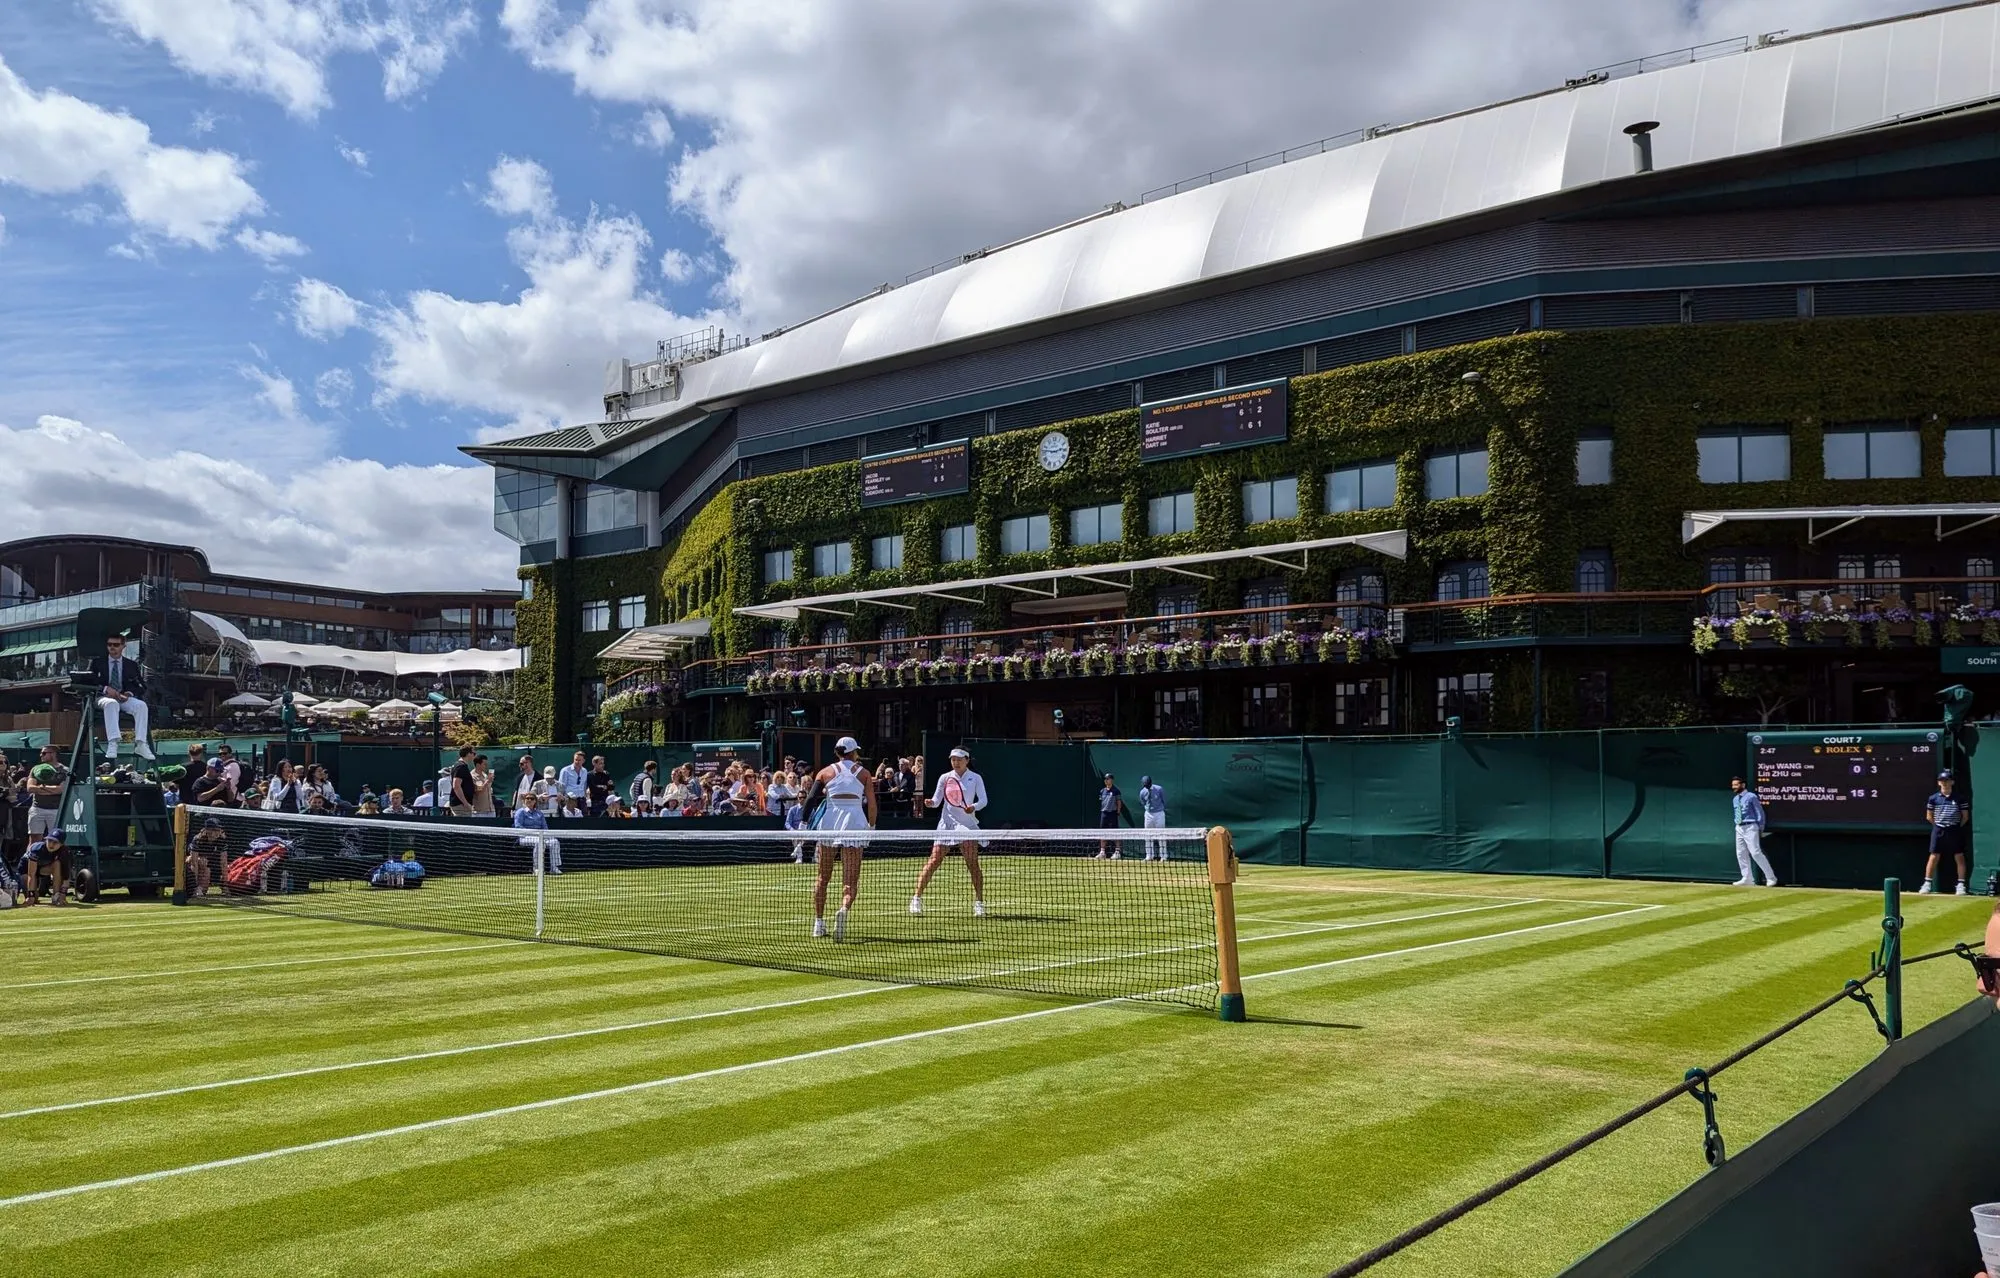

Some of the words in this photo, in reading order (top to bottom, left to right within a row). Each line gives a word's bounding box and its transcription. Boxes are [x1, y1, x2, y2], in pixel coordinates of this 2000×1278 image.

[1165, 404, 1183, 412] COURT
[1204, 396, 1227, 406] SINGLES
[1228, 392, 1250, 401] SECOND
[1252, 388, 1272, 397] ROUND
[1239, 408, 1244, 416] 6
[1248, 421, 1253, 429] 6
[1257, 420, 1262, 428] 1
[1145, 426, 1169, 435] BOULTER
[1145, 441, 1159, 449] DART
[1967, 657, 1997, 665] SOUTH
[1758, 763, 1775, 771] Xiyu
[1853, 765, 1861, 773] 0
[1871, 765, 1877, 773] 3
[1851, 789, 1864, 797] 15
[1871, 789, 1878, 797] 2
[1783, 794, 1796, 802] Lily
[66, 824, 87, 833] BARCLAYS
